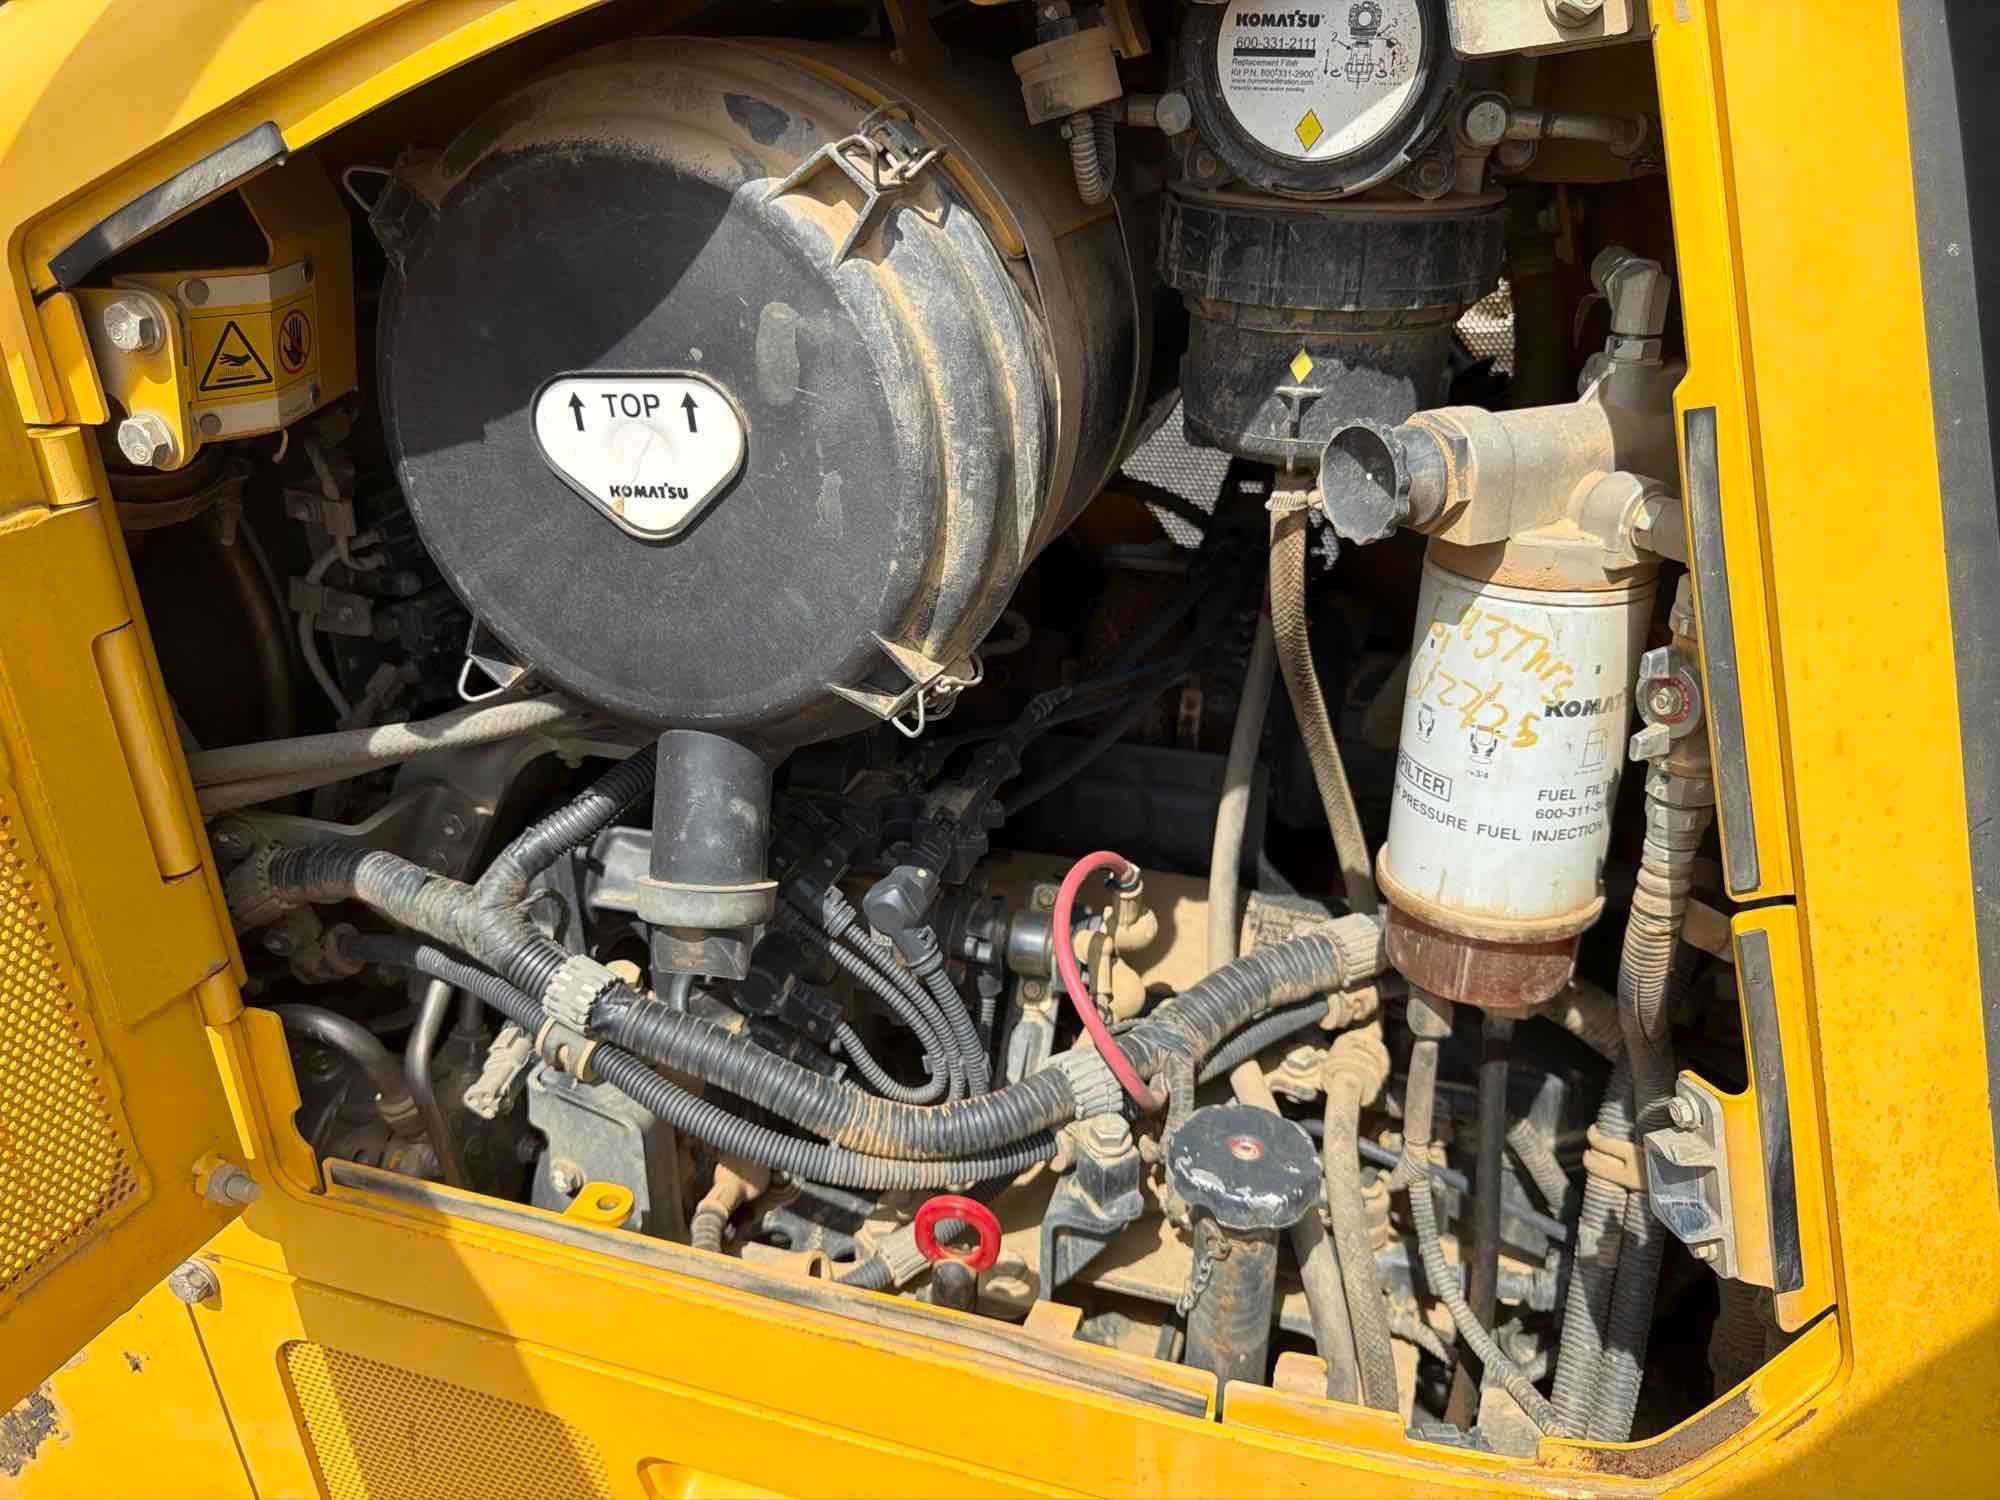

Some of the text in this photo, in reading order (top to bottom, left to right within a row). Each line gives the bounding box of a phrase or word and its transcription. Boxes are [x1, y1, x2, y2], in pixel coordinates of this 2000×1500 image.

[1236, 10, 1320, 27] KOMATSU
[1236, 37, 1316, 49] 600-331-2111
[602, 394, 660, 418] TOP
[609, 482, 688, 499] KOMATSU
[1537, 788, 1577, 802] FUEL
[1402, 789, 1468, 832] PRESSURE
[1476, 822, 1521, 841] FUEL
